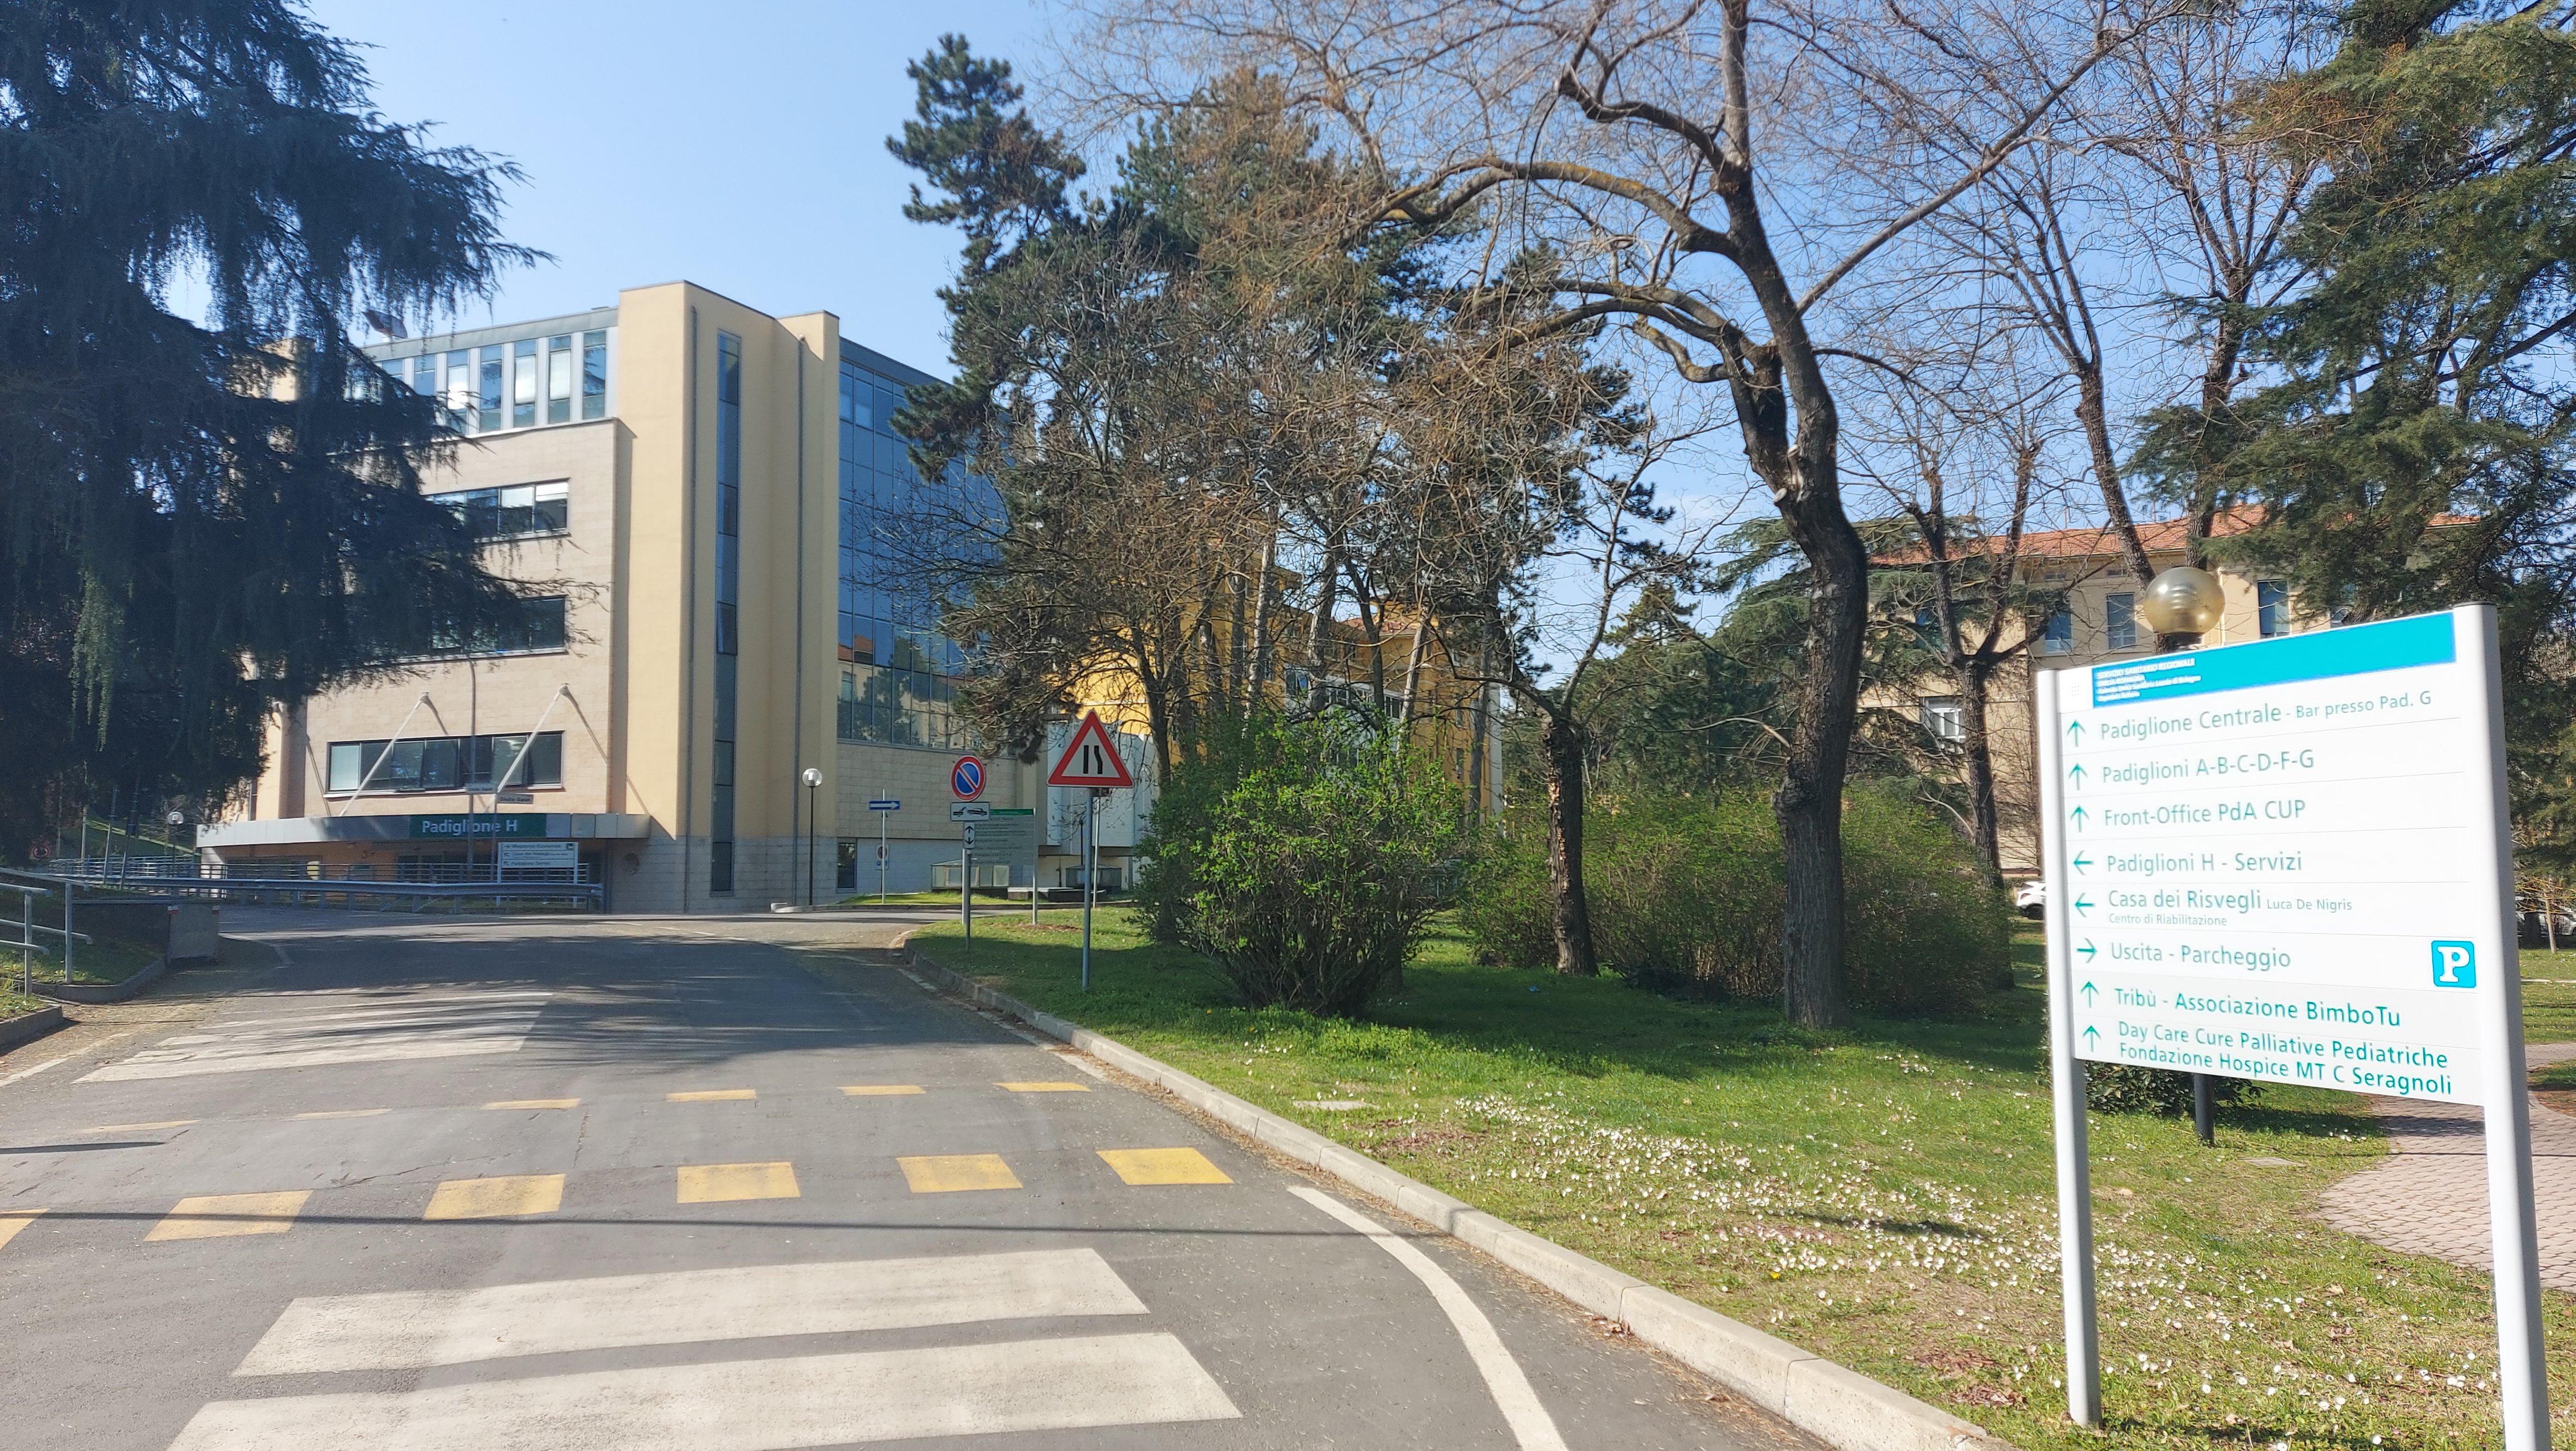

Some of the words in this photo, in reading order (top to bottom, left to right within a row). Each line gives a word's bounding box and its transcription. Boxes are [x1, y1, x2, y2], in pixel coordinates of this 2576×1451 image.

[2101, 717, 2192, 741] Padiglione
[2200, 703, 2282, 729] Centrale
[2295, 705, 2320, 719] Bar
[2325, 701, 2374, 719] presso
[2379, 693, 2414, 709] Pad.
[2420, 691, 2432, 705] G
[2103, 759, 2188, 785] Padiglioni
[2197, 749, 2314, 776] A-B-C-D-F-G
[506, 820, 517, 832] H
[2104, 805, 2211, 826] Front-Office
[2219, 802, 2257, 821] PdA
[2265, 800, 2306, 820] CUP
[2107, 853, 2194, 877] Padiglioni
[2202, 854, 2214, 871] H
[2235, 851, 2302, 871] Servizi
[2109, 890, 2148, 907] Casa
[2153, 889, 2180, 908] dei
[2187, 889, 2262, 914] Risvegli
[2267, 899, 2292, 909] Luca
[2297, 899, 2312, 910] De
[2317, 899, 2352, 913] Nigris
[2110, 914, 2141, 923] Centro
[2145, 914, 2153, 924] di
[2157, 914, 2227, 926] Riabilitazione
[2112, 943, 2163, 961] Uscita
[2181, 945, 2291, 972] Parcheggio
[2438, 947, 2469, 982] P
[2114, 987, 2158, 1008] Tribù
[2174, 992, 2301, 1020] Associazione
[2306, 1000, 2401, 1028] BimboTu
[2118, 1020, 2149, 1043] Day
[2152, 1025, 2190, 1043] Care
[2194, 1028, 2235, 1048] Cure
[2239, 1031, 2327, 1058] Palliative
[2331, 1040, 2449, 1069] Pediatriche
[2119, 1041, 2214, 1069] Fondazione
[2219, 1053, 2290, 1078] Hospice
[2295, 1060, 2327, 1081] MT
[2333, 1065, 2345, 1083] C
[2351, 1067, 2452, 1096] Seragnoli
